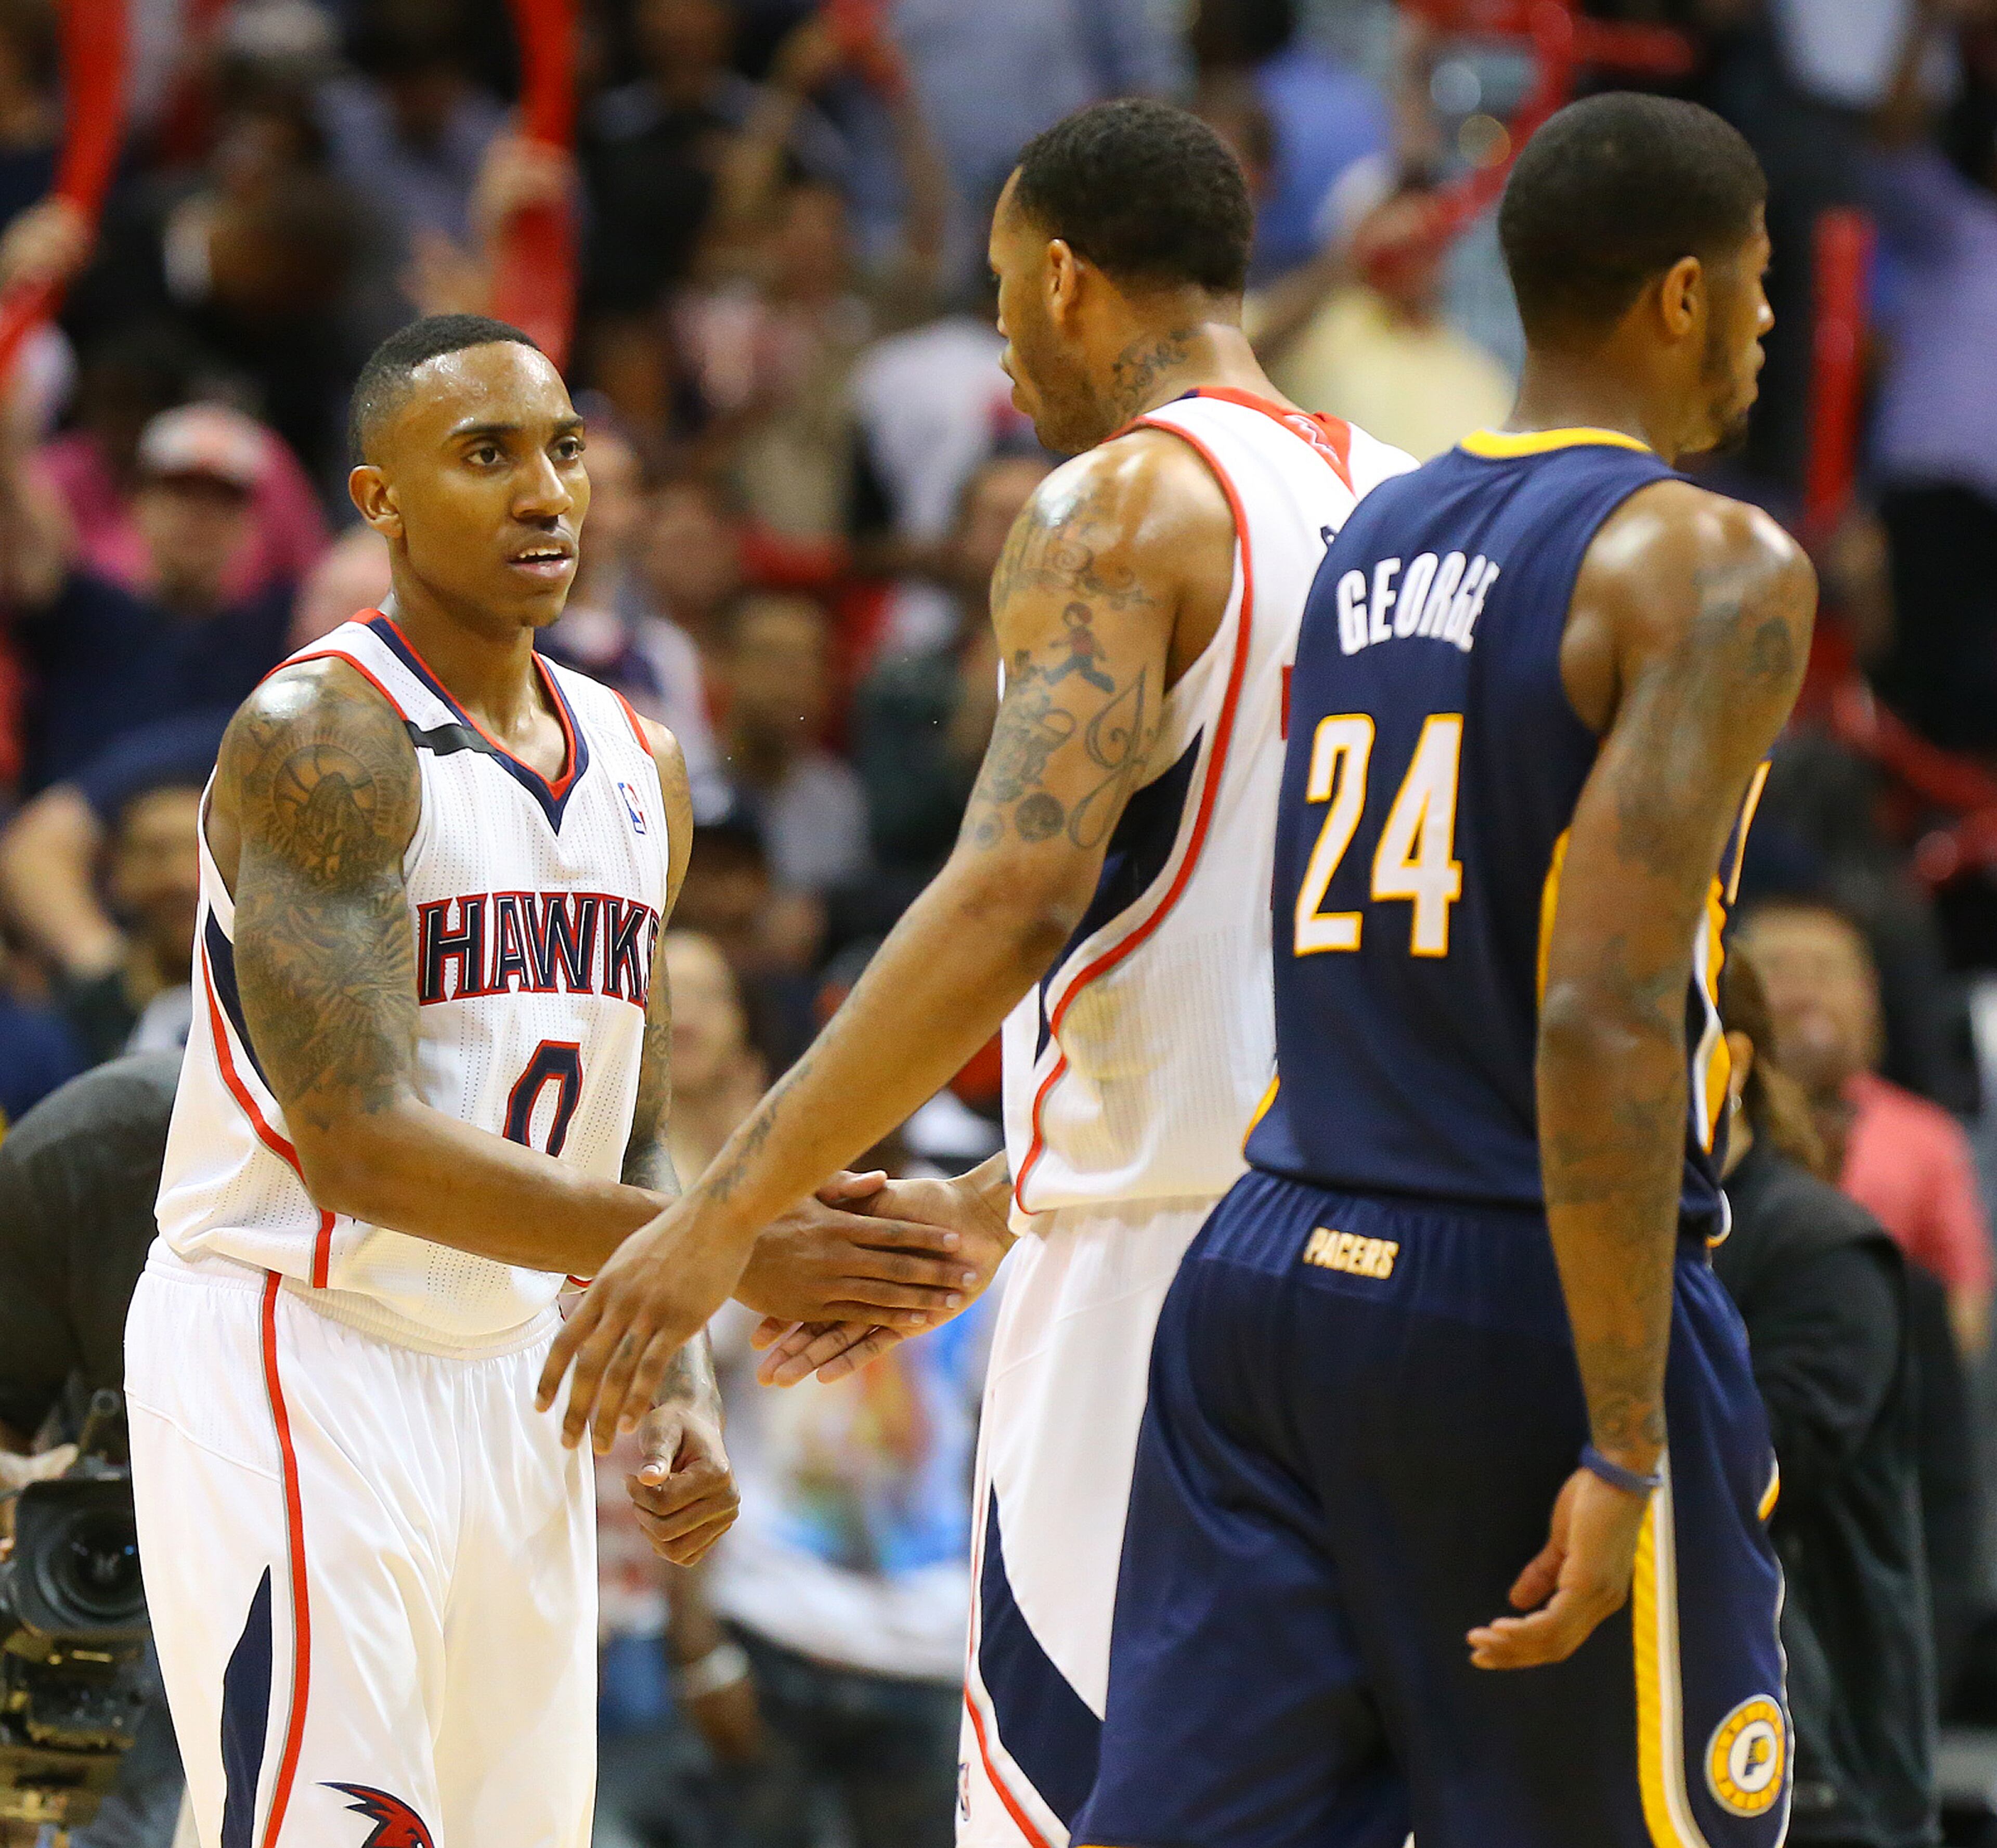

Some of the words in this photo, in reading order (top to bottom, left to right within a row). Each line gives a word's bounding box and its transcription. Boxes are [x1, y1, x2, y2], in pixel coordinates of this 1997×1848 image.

[1337, 550, 1500, 656] GEORGE
[1293, 712, 1464, 958] 24
[1303, 1226, 1401, 1280] PACERS
